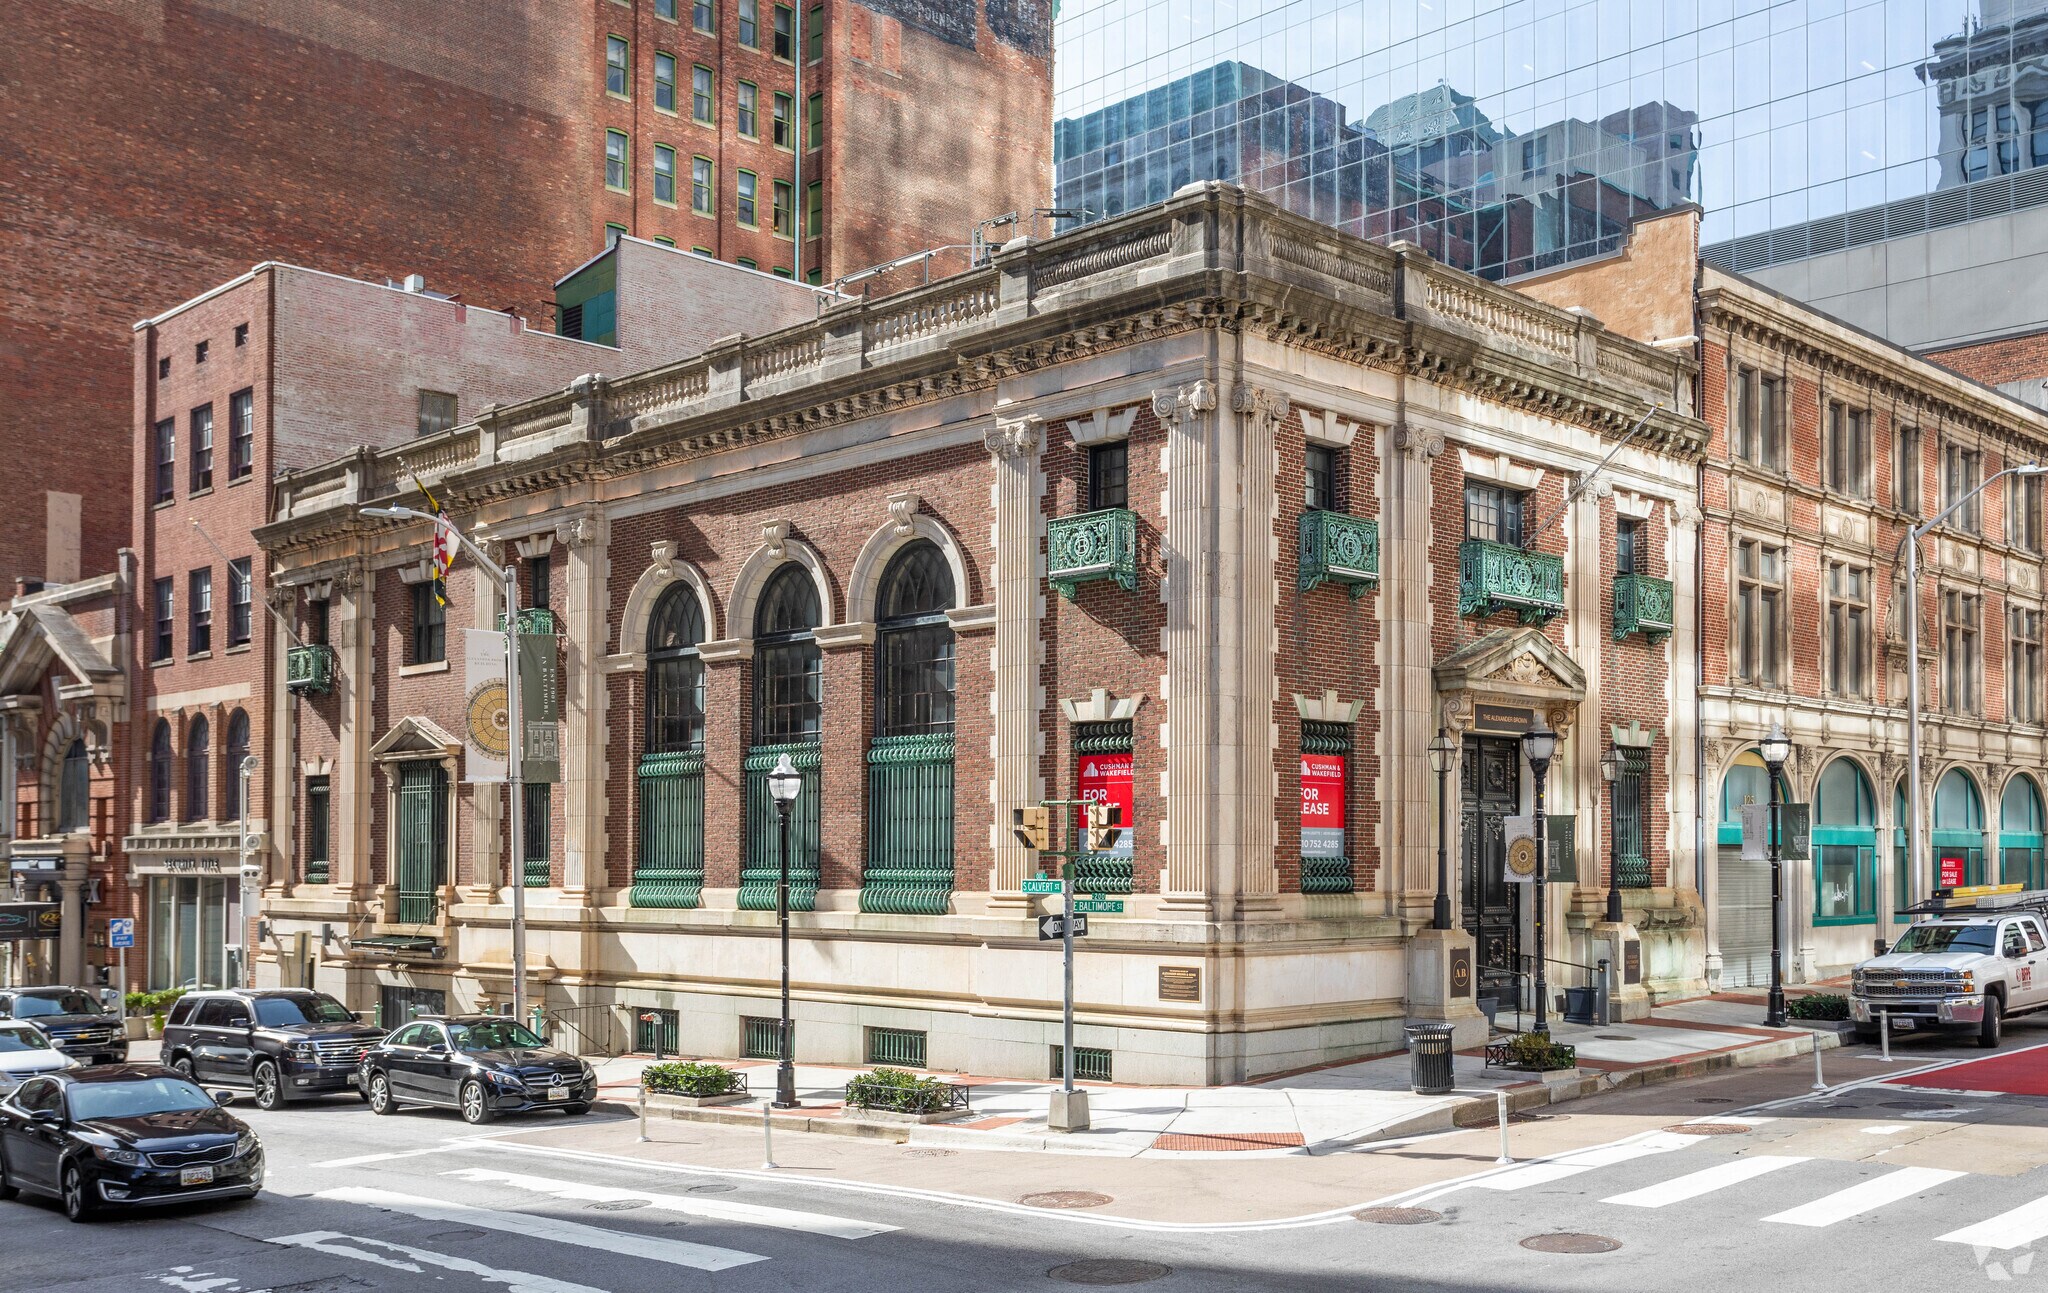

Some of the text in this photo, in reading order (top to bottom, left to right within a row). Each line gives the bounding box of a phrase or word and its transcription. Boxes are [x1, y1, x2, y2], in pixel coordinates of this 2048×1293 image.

[542, 656, 547, 664] IN
[1490, 714, 1512, 722] ALEXANDER
[1083, 788, 1108, 801] FOR
[1114, 840, 1133, 848] 4285
[1310, 840, 1322, 848] 752
[1322, 840, 1339, 848] 4285
[1022, 882, 1026, 890] S
[1027, 882, 1053, 892] CALVERT
[1080, 902, 1116, 911] BALTIMORE
